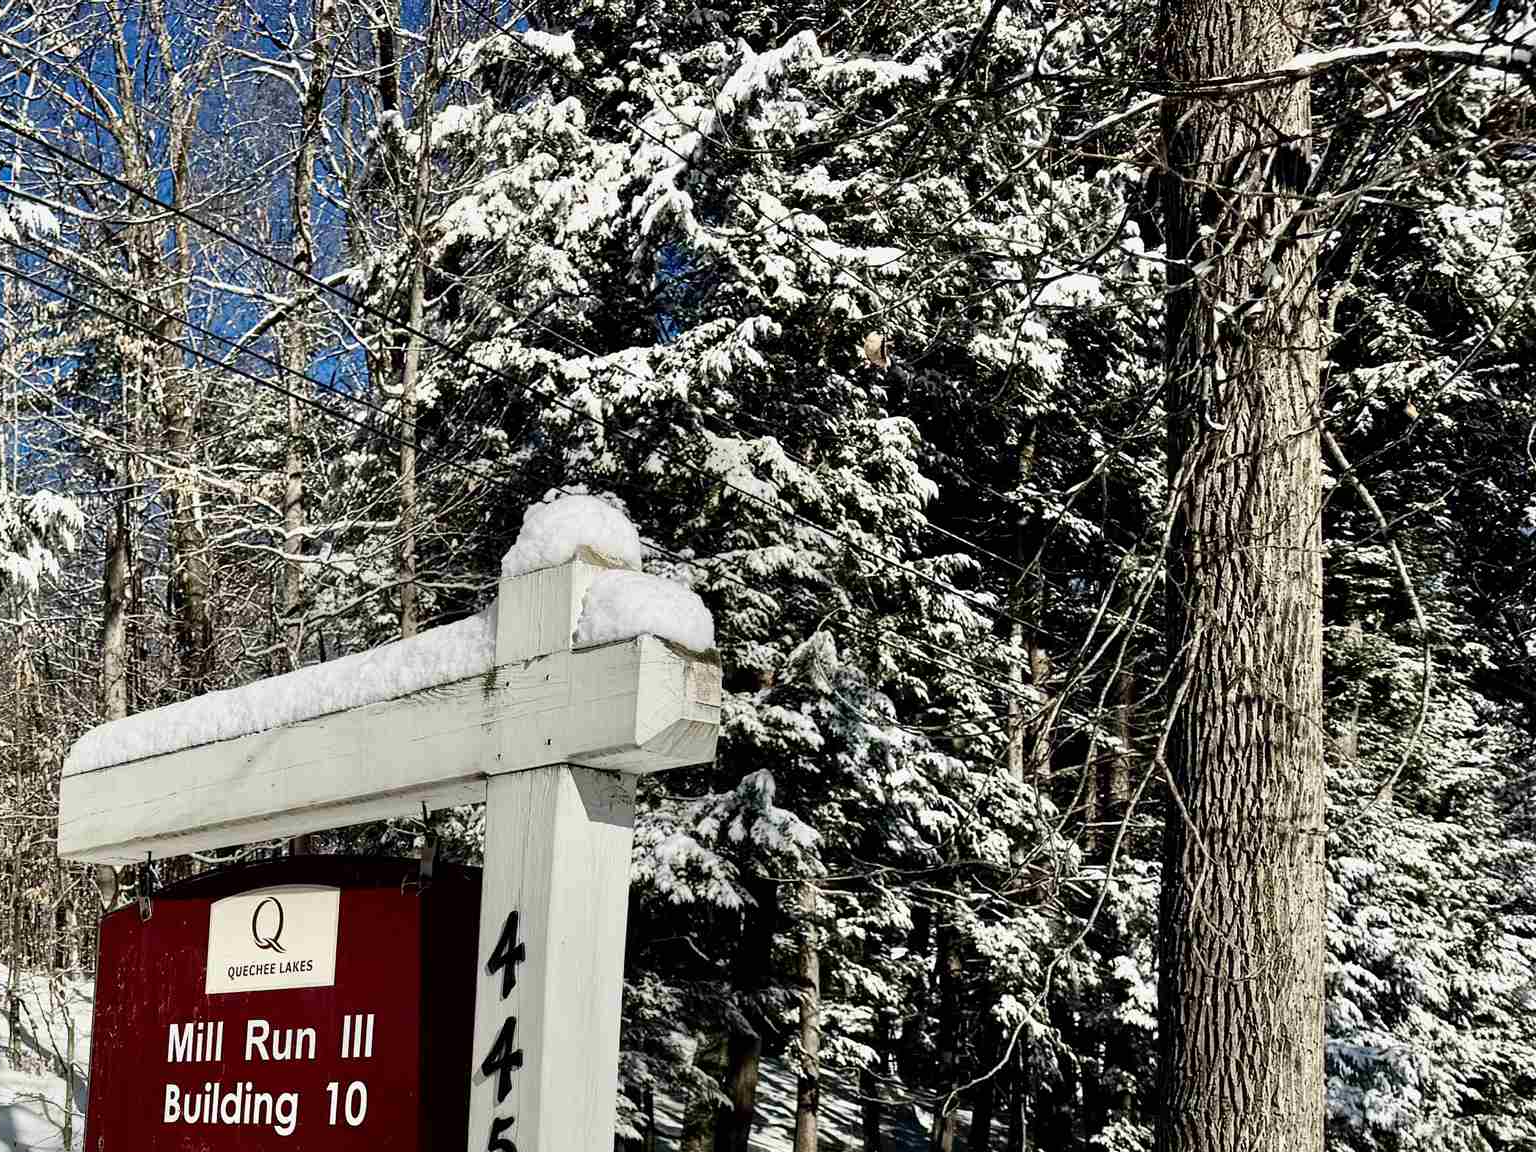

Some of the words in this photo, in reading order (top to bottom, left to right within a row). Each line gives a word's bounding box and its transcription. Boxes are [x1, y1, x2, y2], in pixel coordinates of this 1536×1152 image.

[251, 896, 286, 953] Q
[227, 961, 277, 979] QUECHEE
[279, 959, 313, 975] LAKES
[167, 1021, 224, 1062] Mill
[245, 1019, 316, 1061] Run
[341, 1013, 375, 1058] III
[164, 1081, 299, 1136] Building
[325, 1081, 368, 1126] 10
